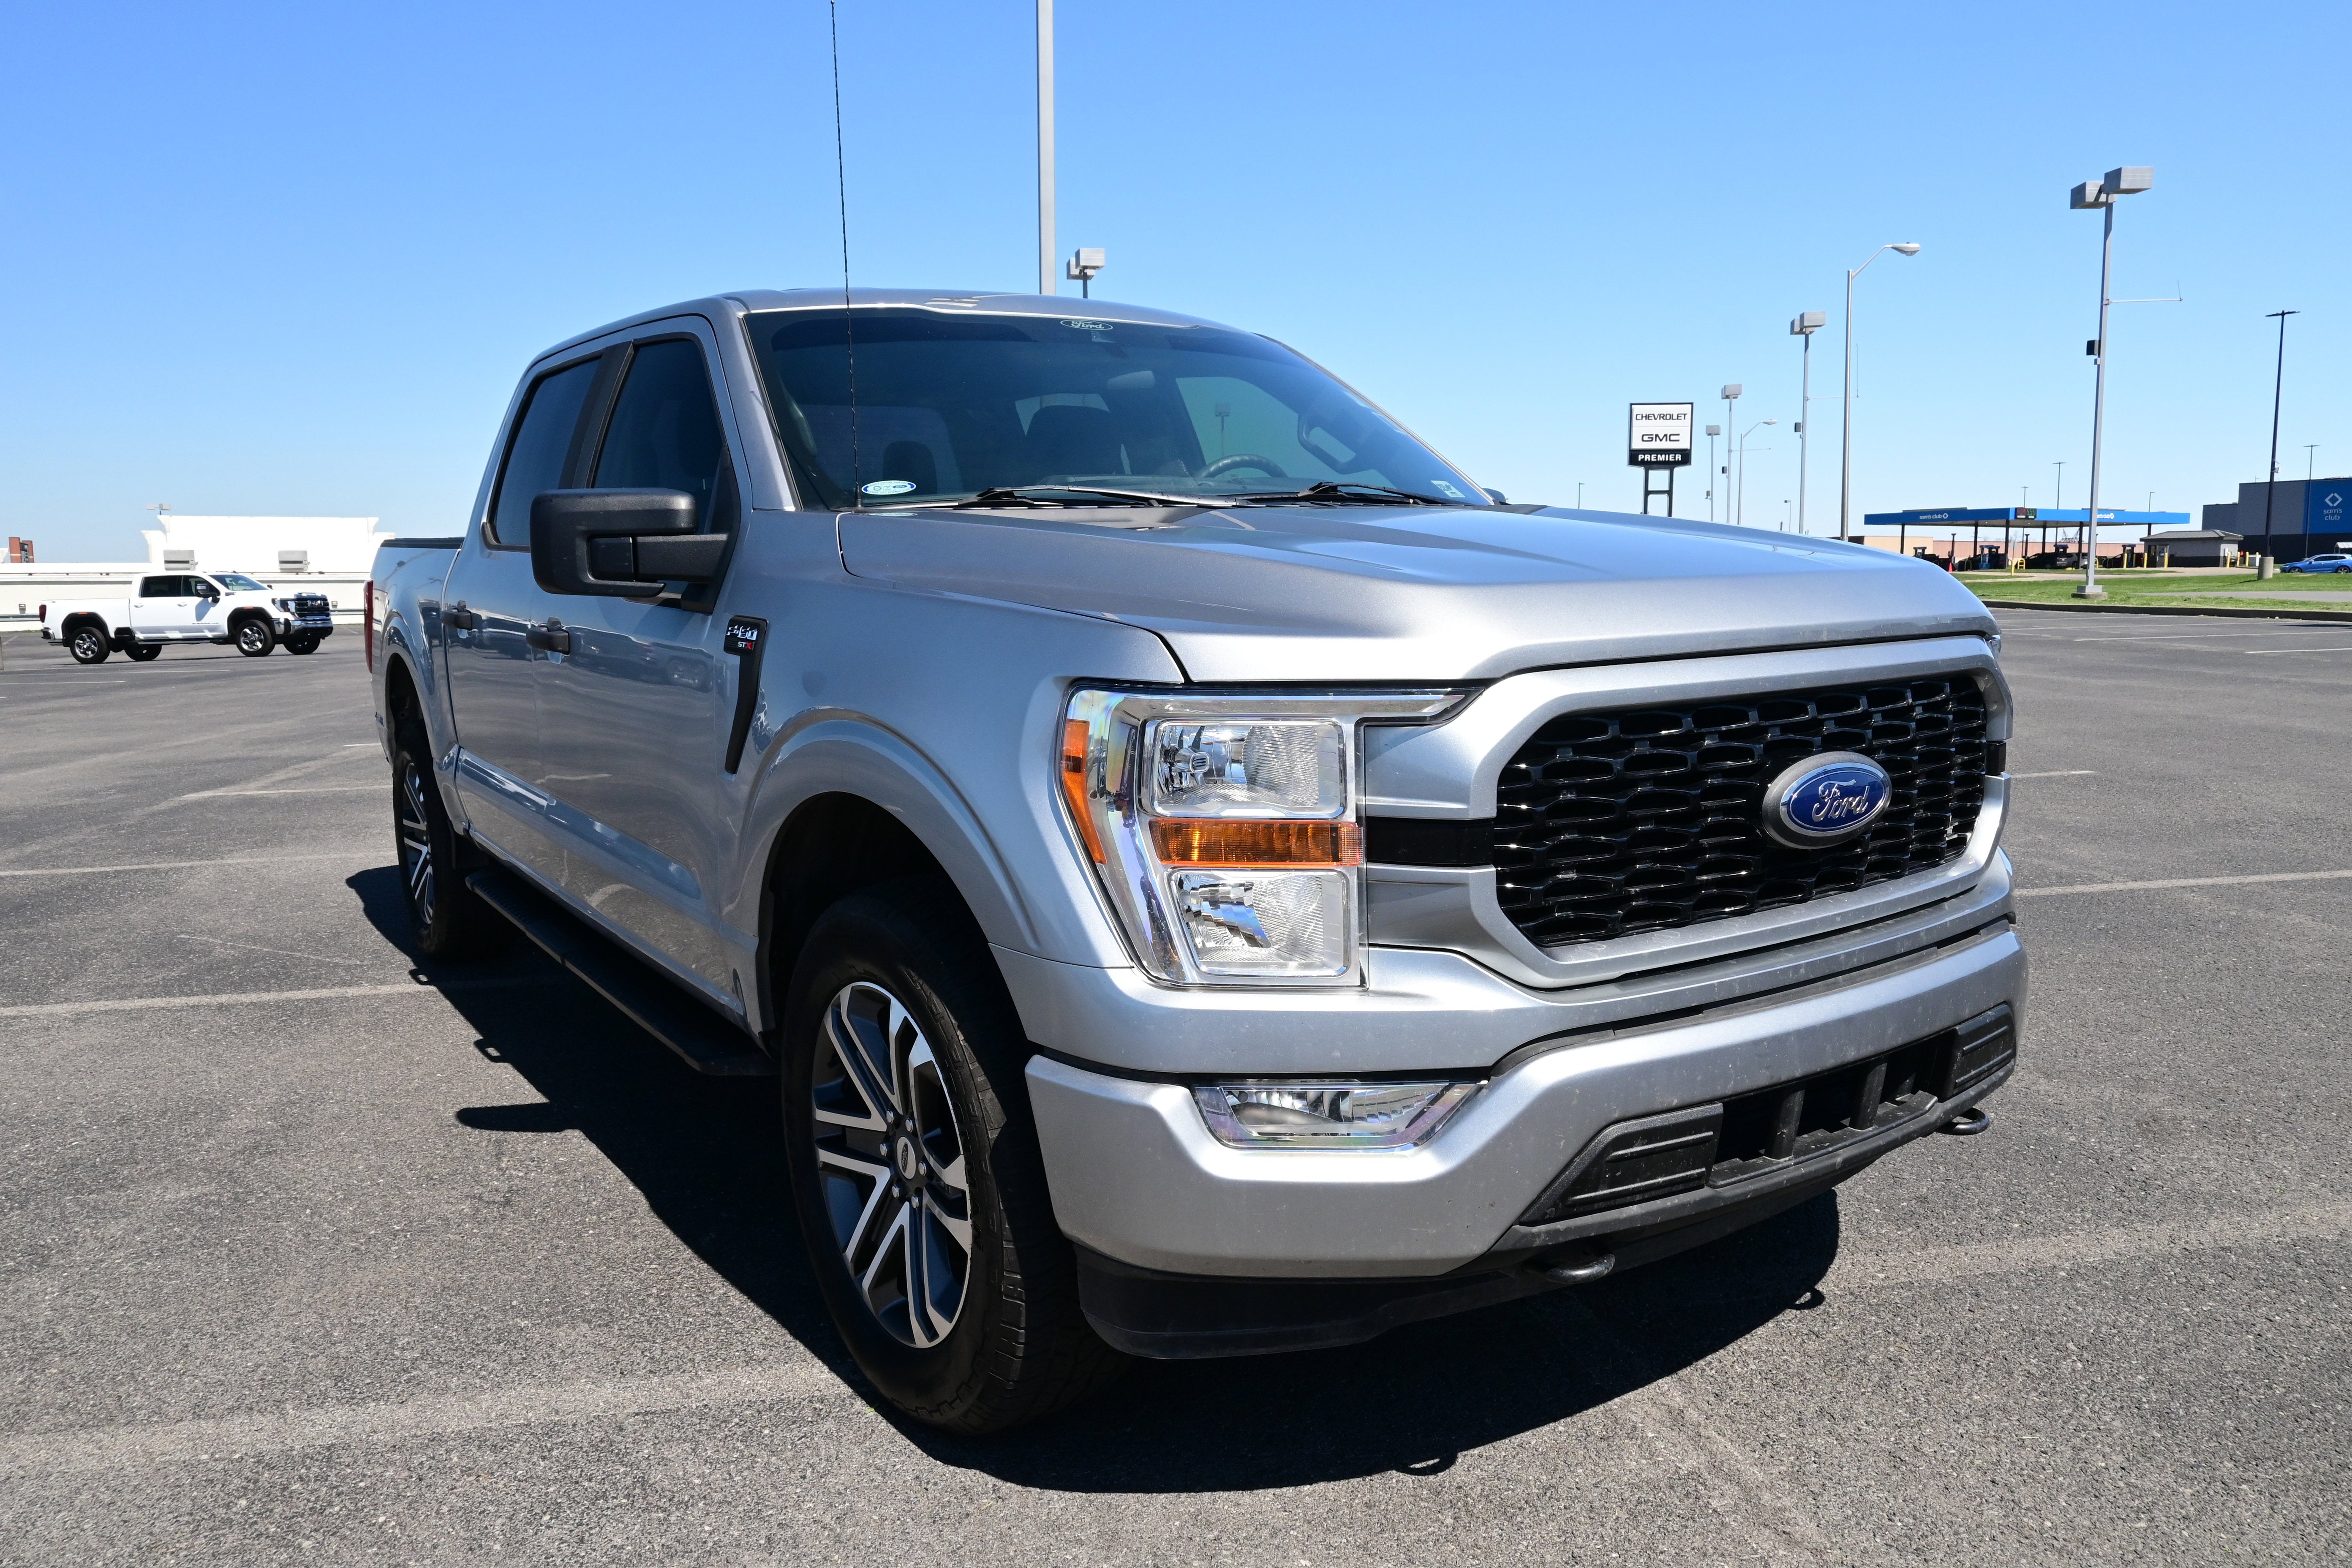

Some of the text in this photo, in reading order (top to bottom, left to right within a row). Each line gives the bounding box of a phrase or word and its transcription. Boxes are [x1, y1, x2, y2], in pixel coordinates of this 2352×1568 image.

[1071, 321, 1105, 329] Ford
[1642, 433, 1680, 442] GMC
[738, 641, 753, 650] STX
[1812, 779, 1870, 822] Ford
